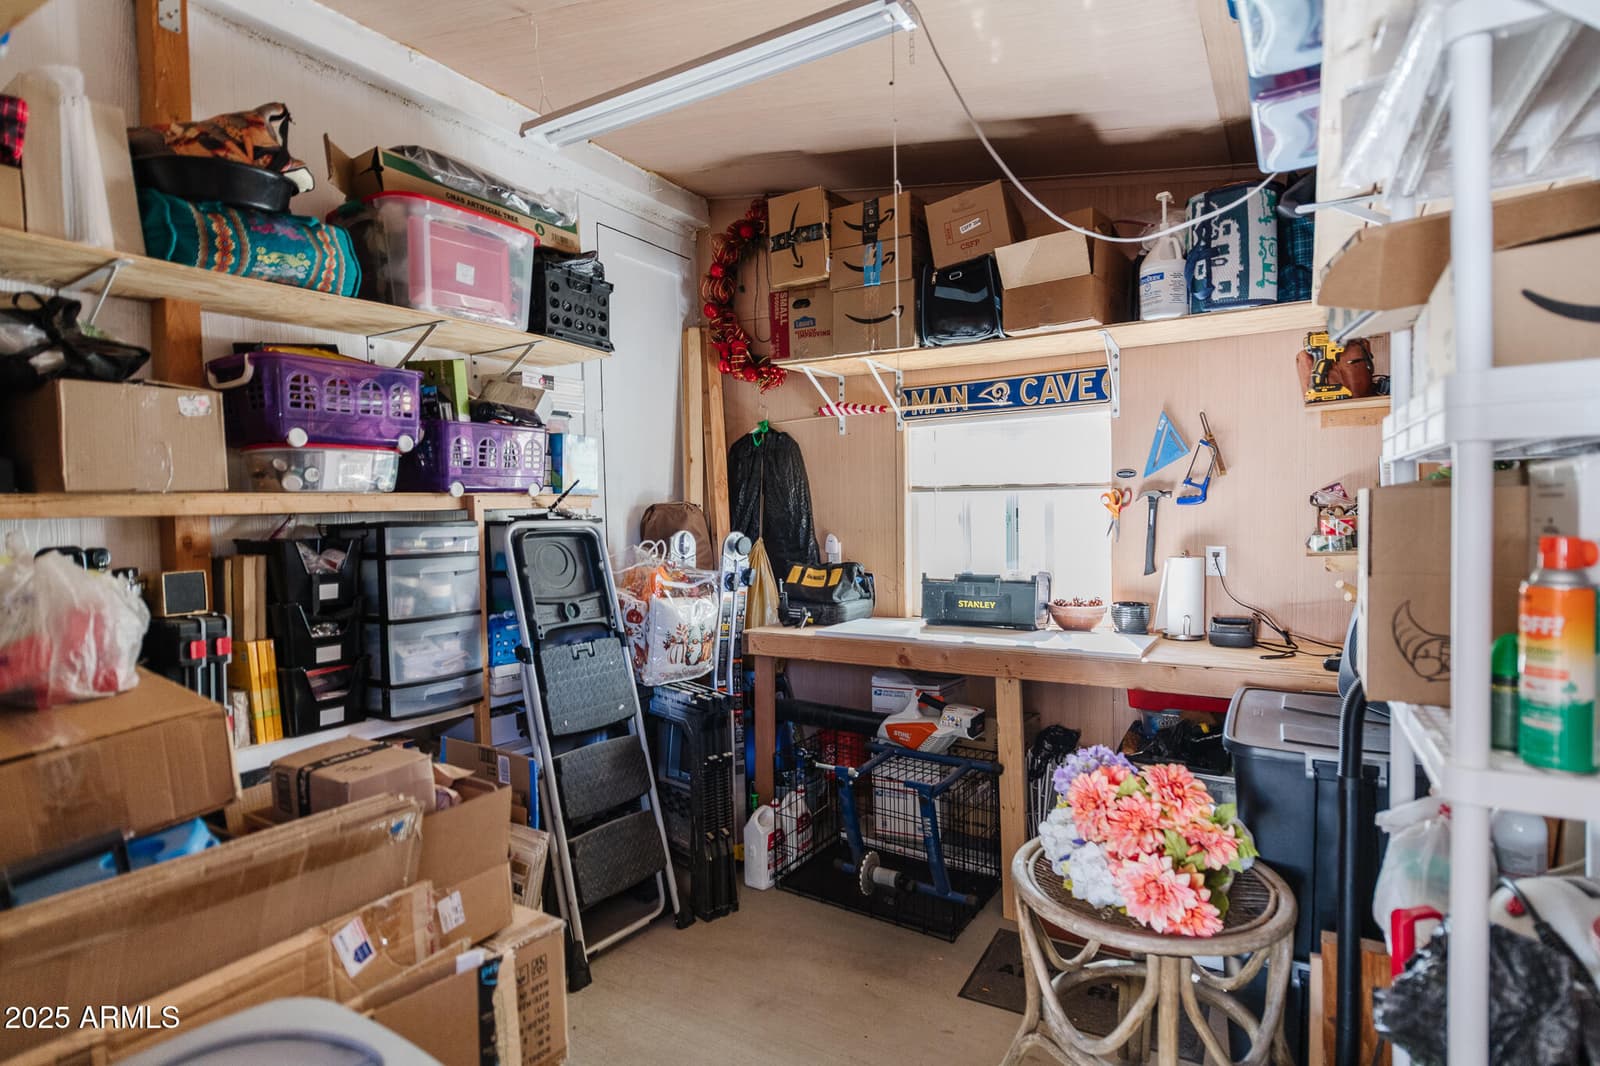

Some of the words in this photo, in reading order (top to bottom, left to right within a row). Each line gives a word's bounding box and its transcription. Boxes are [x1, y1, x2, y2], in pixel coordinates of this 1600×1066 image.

[467, 198, 502, 217] ARTIFICIAL
[503, 213, 519, 223] TREE
[779, 292, 788, 326] SMALL
[911, 385, 969, 416] MAN
[1019, 371, 1097, 405] CAVE
[958, 600, 996, 609] STANLEY
[893, 730, 911, 739] STIHL
